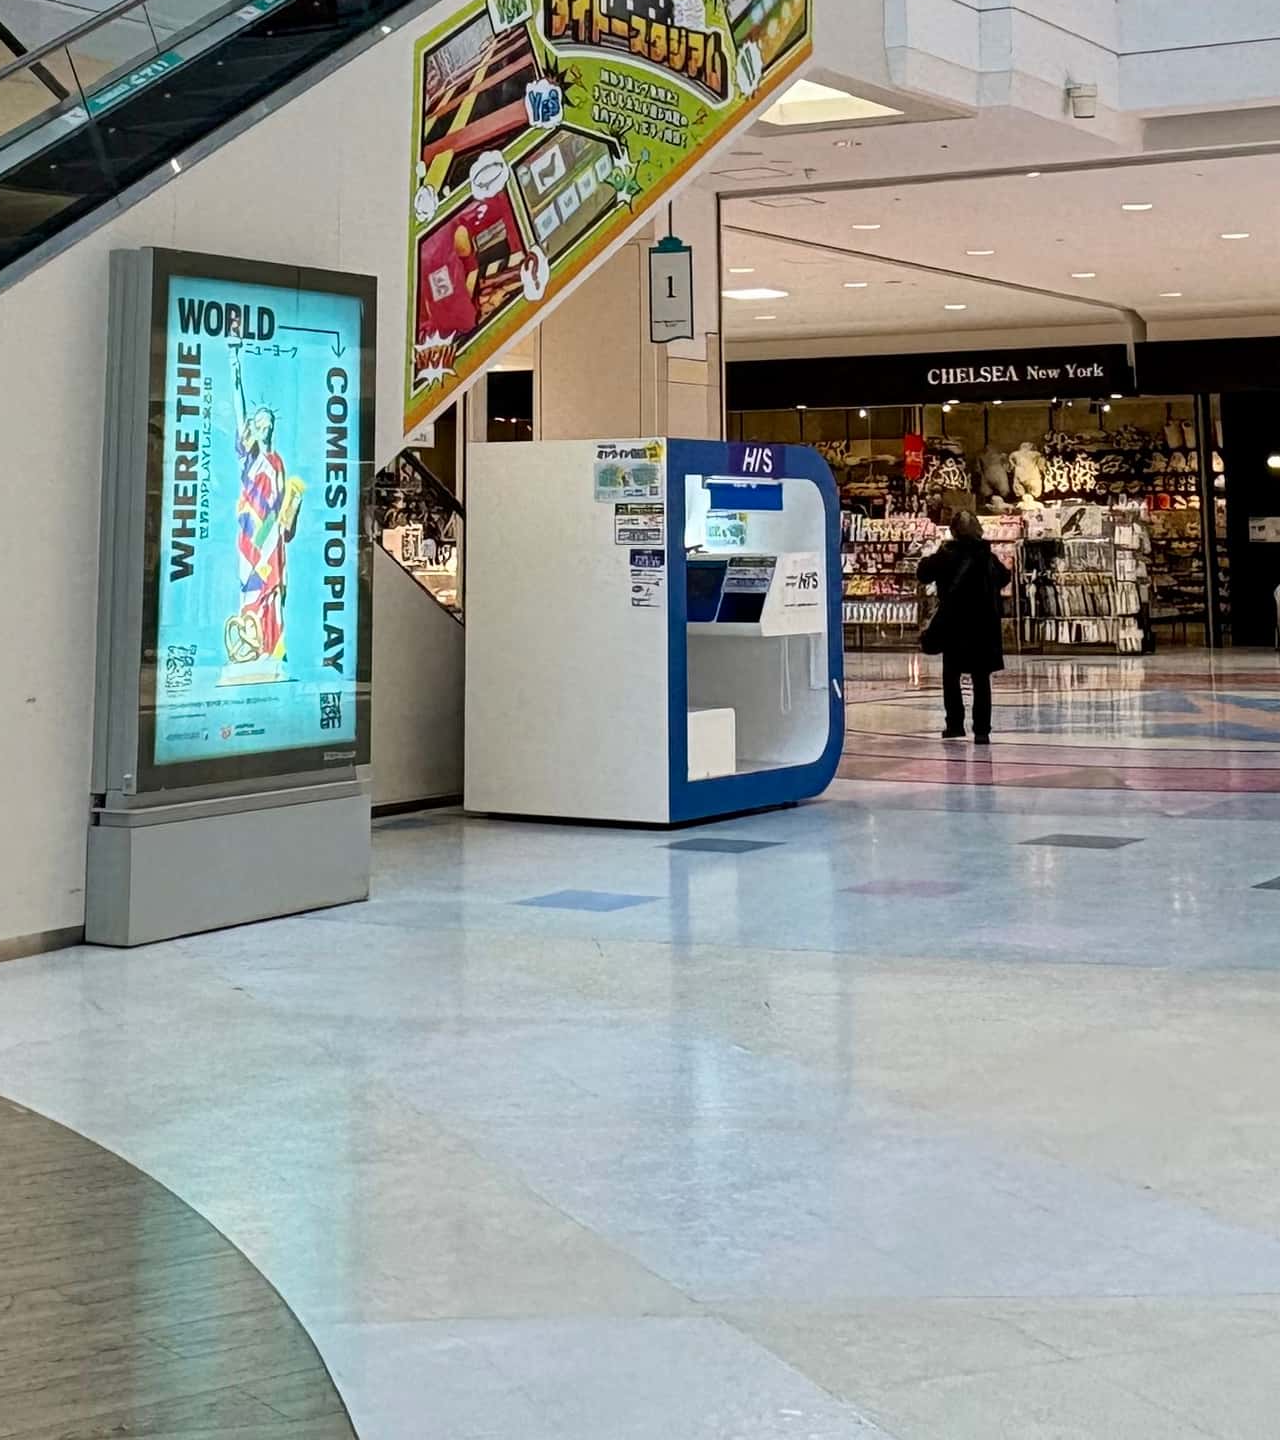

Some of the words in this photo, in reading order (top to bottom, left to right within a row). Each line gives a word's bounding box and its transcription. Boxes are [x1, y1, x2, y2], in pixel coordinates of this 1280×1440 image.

[666, 275, 677, 298] 1
[178, 297, 276, 341] WORLD
[245, 342, 298, 359] ニューヨーク
[927, 365, 1019, 385] CHELSEA
[1026, 365, 1061, 380] New
[1065, 363, 1104, 378] York
[176, 342, 202, 422] THE
[324, 366, 349, 509] COMES
[742, 447, 773, 473] HIS
[170, 429, 200, 582] WHERE
[323, 514, 347, 568] TO
[322, 575, 346, 675] PLAY
